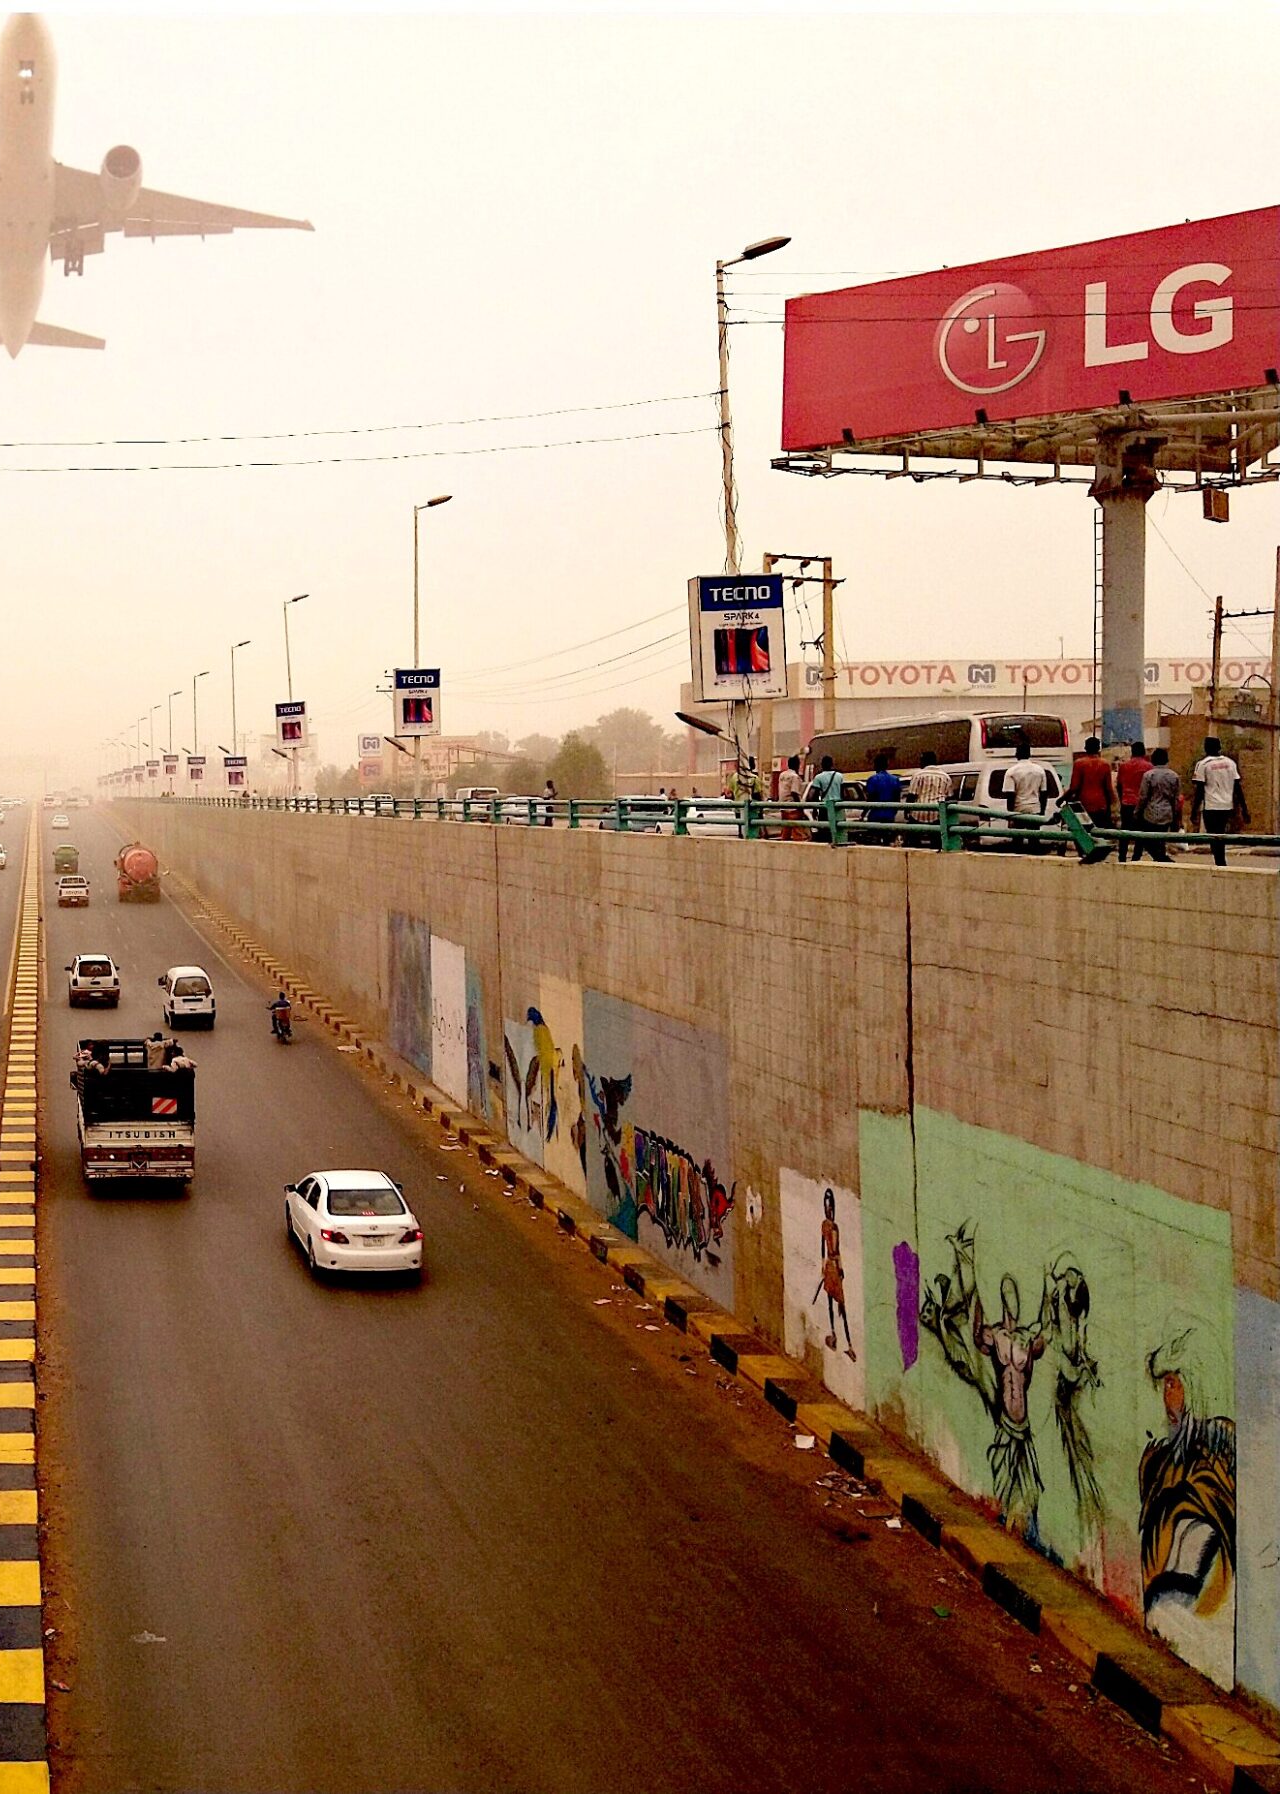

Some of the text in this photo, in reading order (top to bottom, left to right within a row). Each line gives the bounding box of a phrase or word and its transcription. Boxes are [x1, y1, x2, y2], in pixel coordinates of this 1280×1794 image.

[1084, 263, 1233, 367] LG
[709, 586, 771, 602] TECNO
[401, 675, 434, 684] TECNO
[843, 664, 956, 686] TOYOTA
[1006, 664, 1095, 684] TOYOT
[280, 705, 302, 714] TECNO
